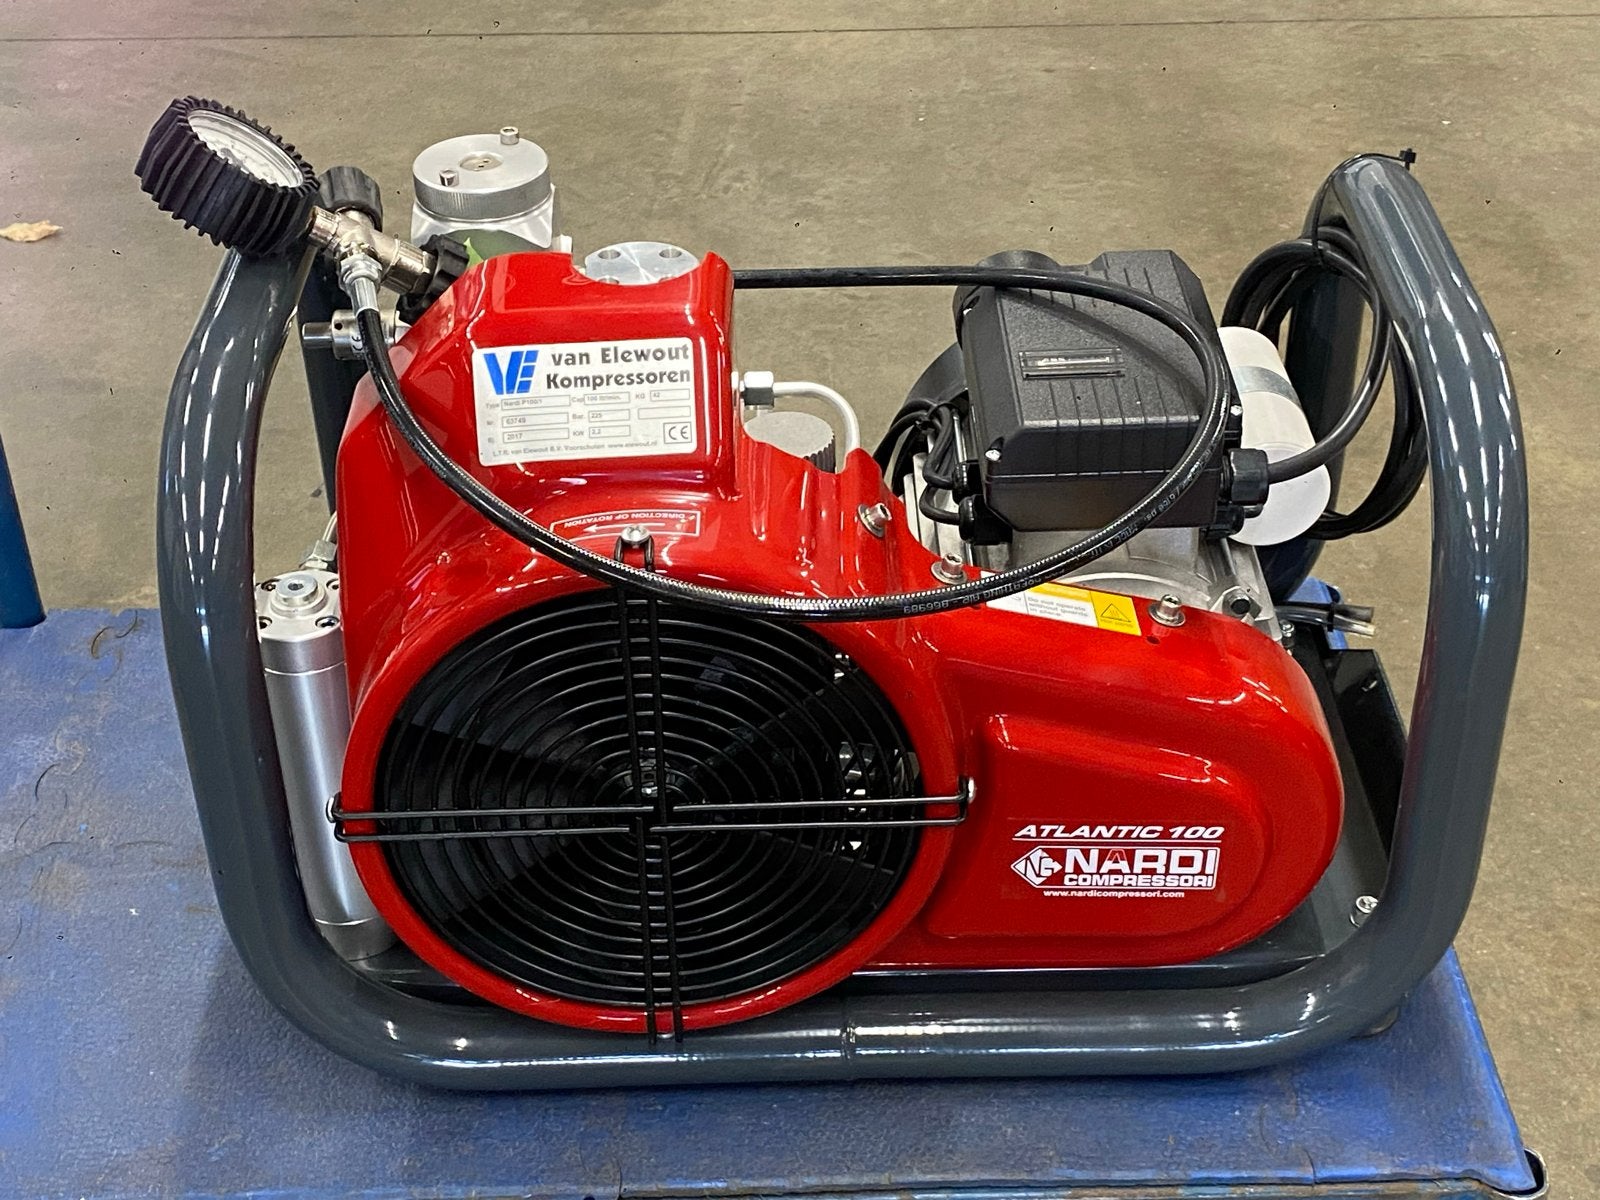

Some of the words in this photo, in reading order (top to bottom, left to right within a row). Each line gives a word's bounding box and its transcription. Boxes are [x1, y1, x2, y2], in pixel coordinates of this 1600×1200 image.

[551, 351, 590, 366] van
[601, 344, 689, 364] Elewout
[546, 369, 691, 390] Kompressoren
[507, 432, 523, 441] 2017
[668, 425, 690, 440] CE
[563, 515, 613, 529] ROTATION
[614, 512, 630, 520] OF
[631, 511, 687, 520] DIRECTION
[1015, 824, 1163, 839] ATLANTIC
[1169, 826, 1225, 839] 100
[1065, 848, 1214, 875] NARDI
[1063, 873, 1214, 888] COMPRESSORI
[1043, 888, 1186, 898] www.nardicompressori.com
